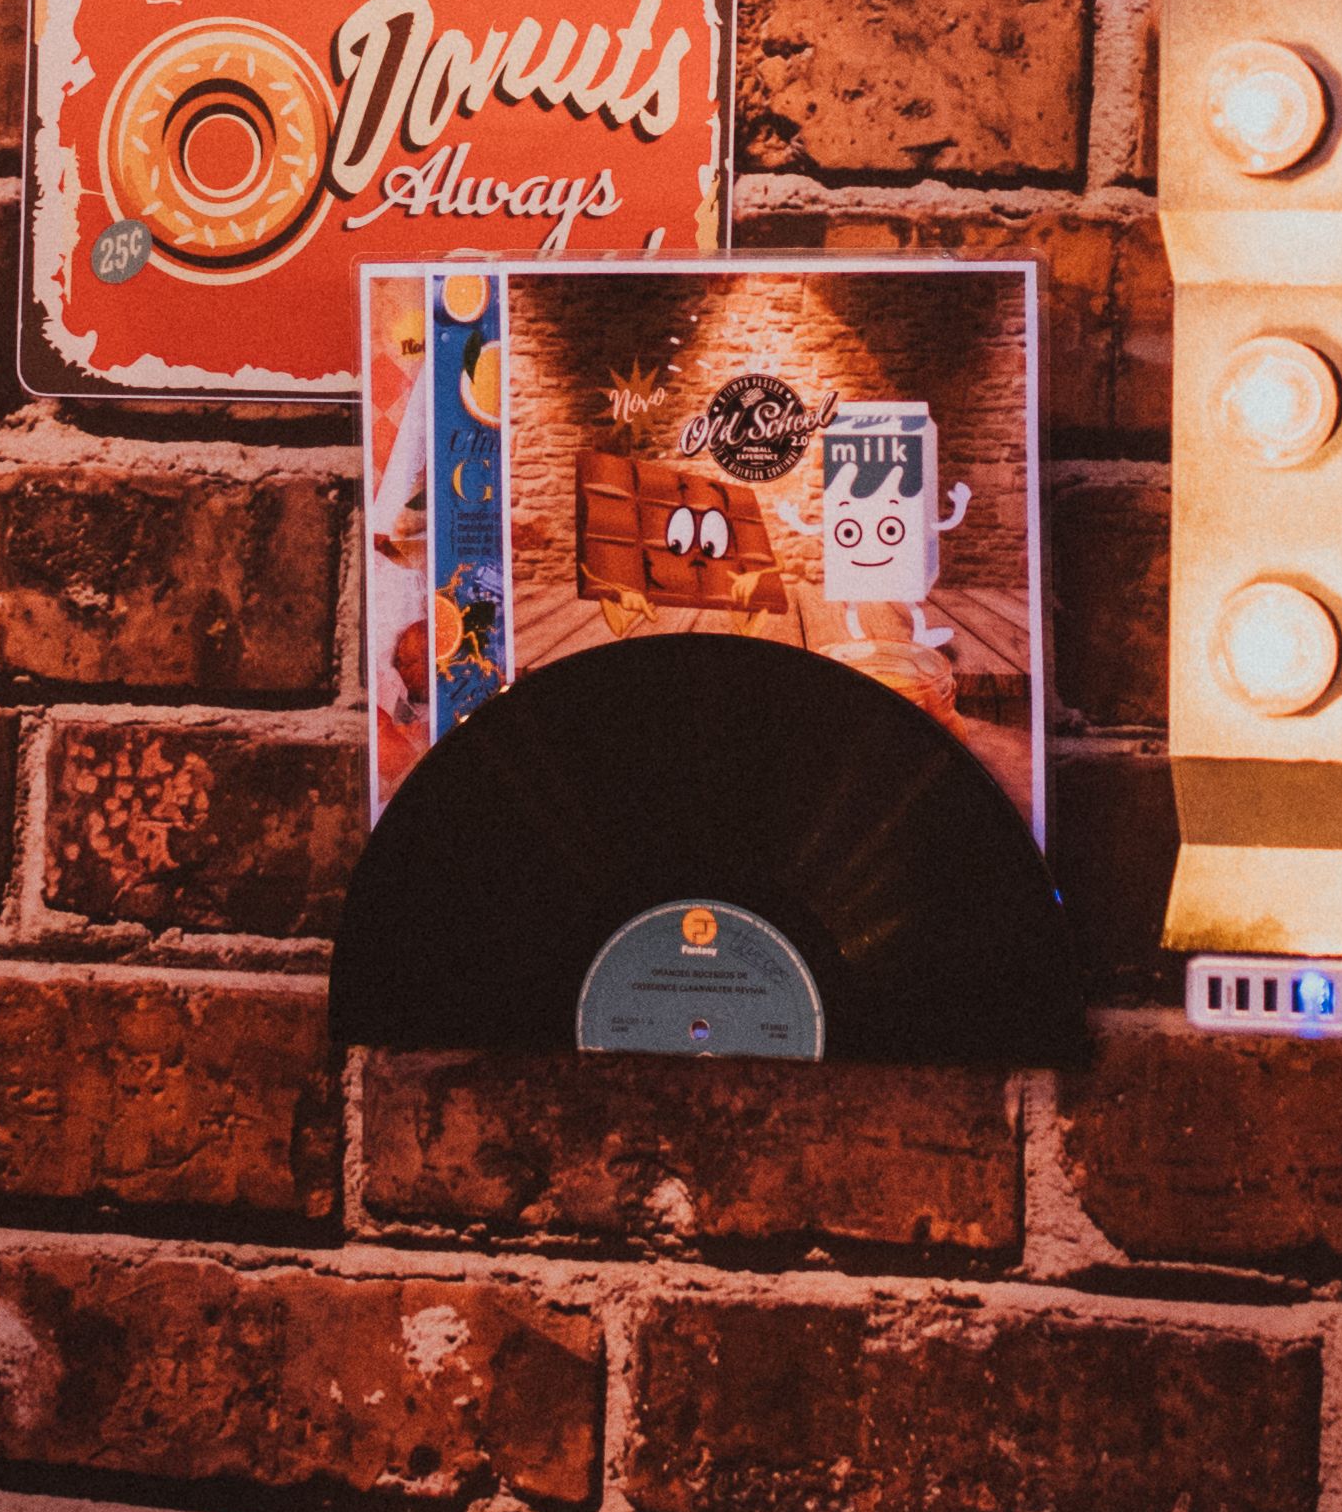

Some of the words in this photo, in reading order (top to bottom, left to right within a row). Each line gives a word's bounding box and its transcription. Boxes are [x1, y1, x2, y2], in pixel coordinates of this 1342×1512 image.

[345, 144, 623, 256] Always
[99, 225, 145, 275] 25¢
[609, 385, 667, 423] Novo
[679, 410, 741, 456] Old
[748, 390, 840, 441] School
[790, 435, 808, 447] 2.0
[831, 435, 909, 465] milk
[681, 944, 719, 958] Fantasy
